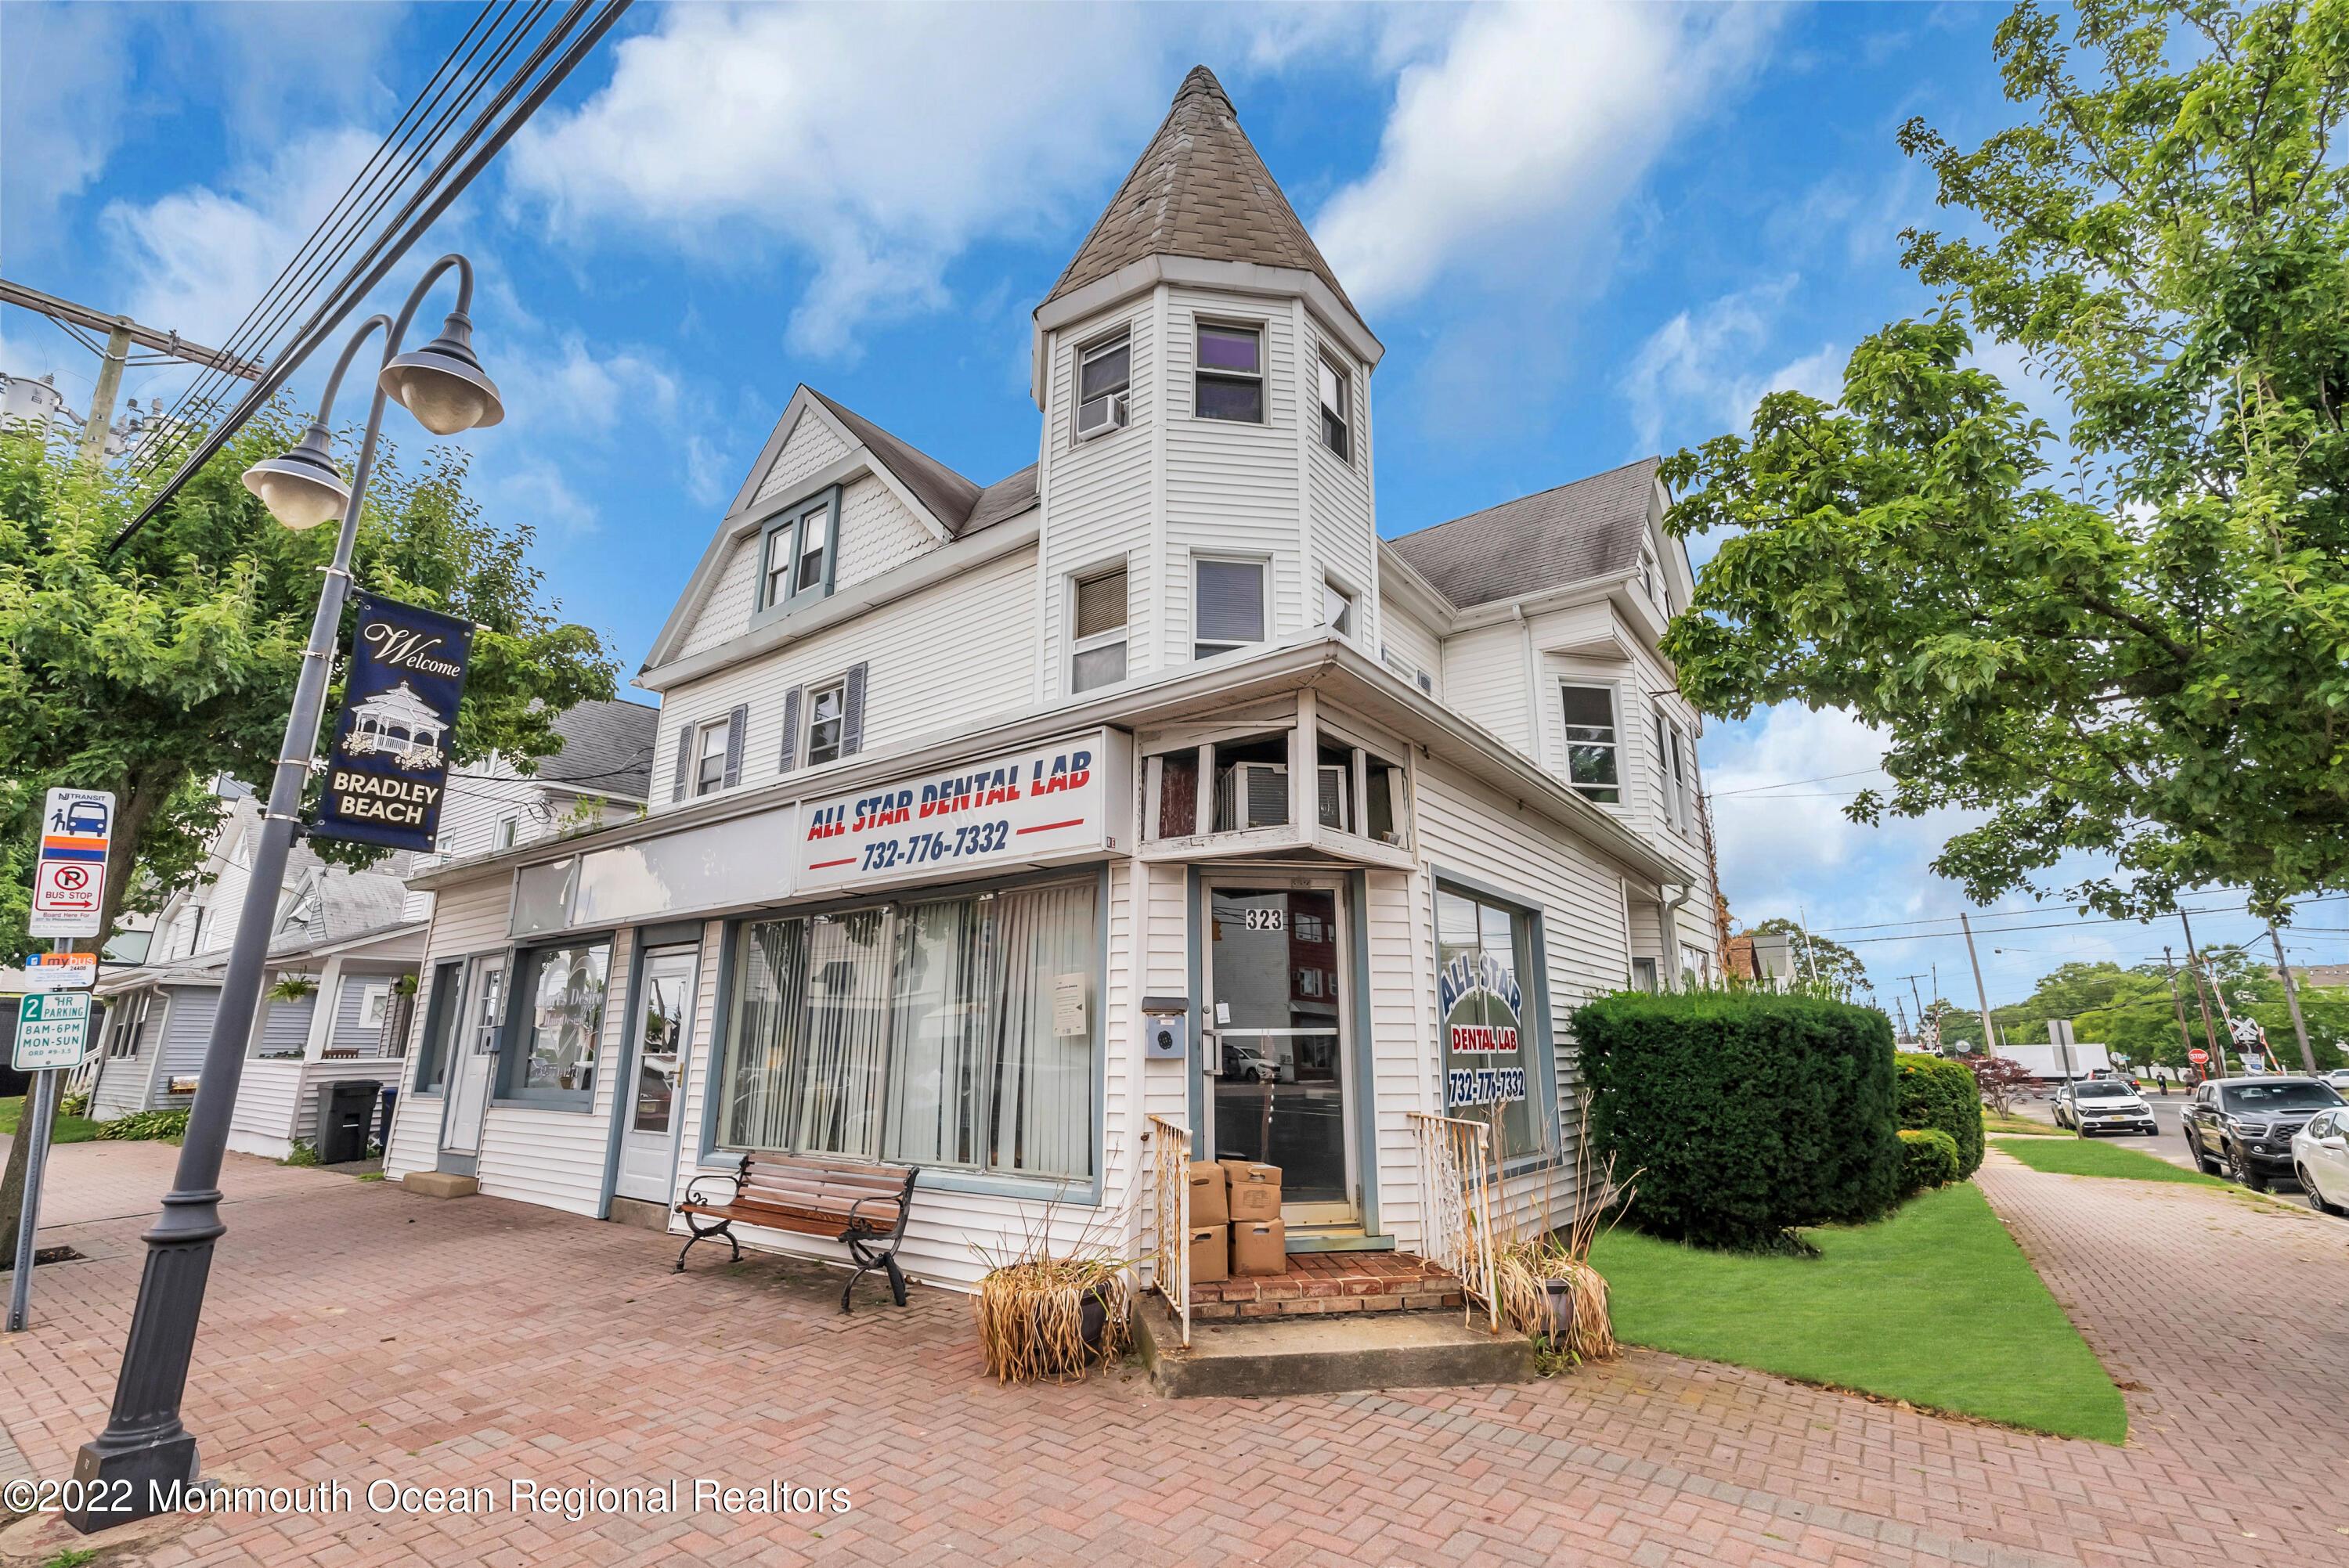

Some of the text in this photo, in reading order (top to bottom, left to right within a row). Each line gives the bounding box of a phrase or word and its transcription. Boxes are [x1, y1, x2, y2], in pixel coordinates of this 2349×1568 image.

[364, 623, 460, 677] Welcome
[333, 772, 438, 805] BRADLEY
[807, 751, 1092, 841] ALL STAR DENTAL LAB
[340, 795, 423, 824] BEACH
[861, 820, 1009, 871] 732-776-7332
[1247, 910, 1282, 929] 323
[570, 988, 604, 1005] Desire
[1442, 953, 1521, 1022] ALL STAR
[26, 997, 74, 1018] 2 HR
[44, 1007, 84, 1018] PARKING
[23, 1036, 80, 1048] MON-SUN
[26, 1023, 81, 1035] 8AM-6PM
[1452, 1027, 1517, 1051] DENTAL LAB
[1450, 1069, 1525, 1104] 732-776-7332
